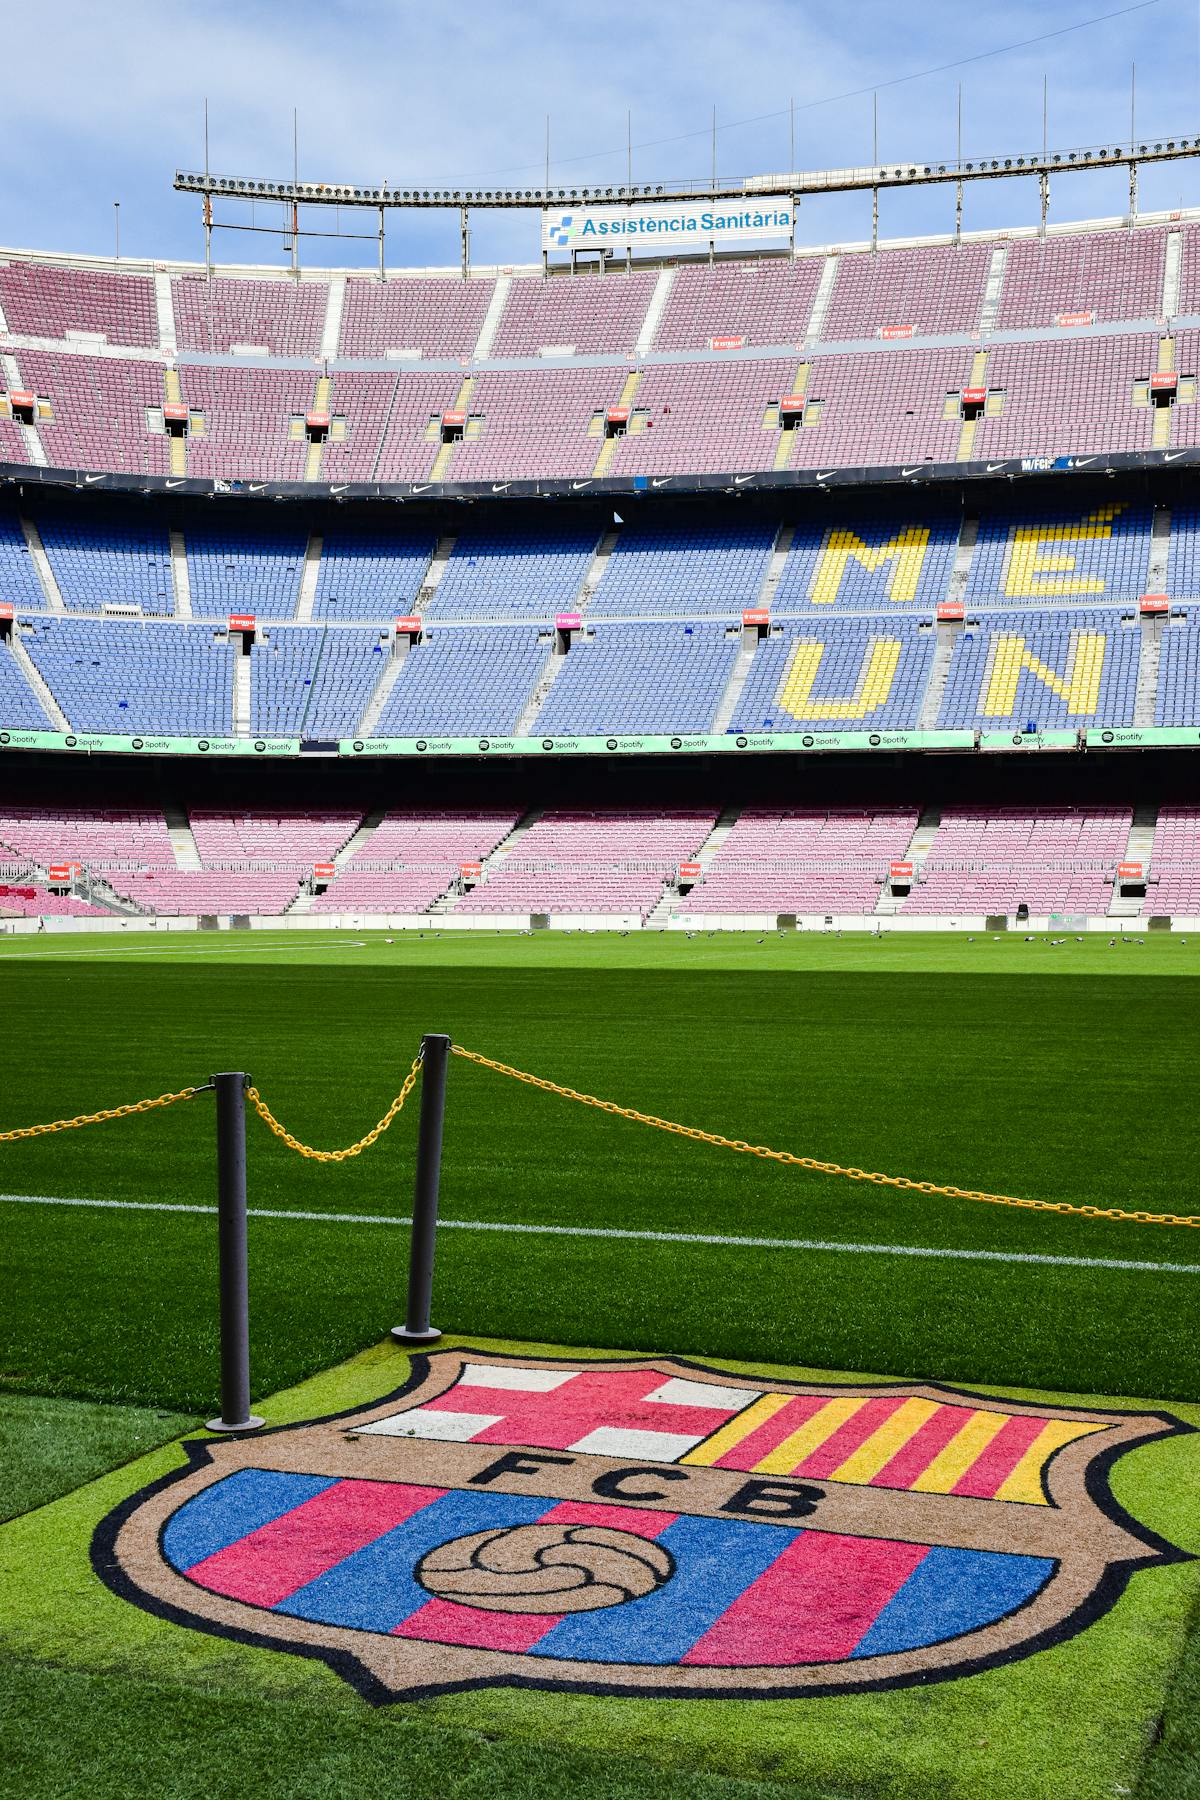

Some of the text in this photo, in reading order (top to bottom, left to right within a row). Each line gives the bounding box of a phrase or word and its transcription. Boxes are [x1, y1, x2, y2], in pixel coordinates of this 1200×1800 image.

[582, 211, 790, 236] Assistència Sanitària
[12, 736, 37, 745] Spotify
[883, 737, 908, 745] Spotify
[1116, 733, 1143, 742] Spotify
[79, 739, 104, 747] Spotify
[211, 743, 236, 751] Spotify
[492, 742, 515, 750] Spotify
[684, 740, 708, 748] Spotify
[750, 739, 774, 747] Spotify
[267, 744, 292, 752] Spotify
